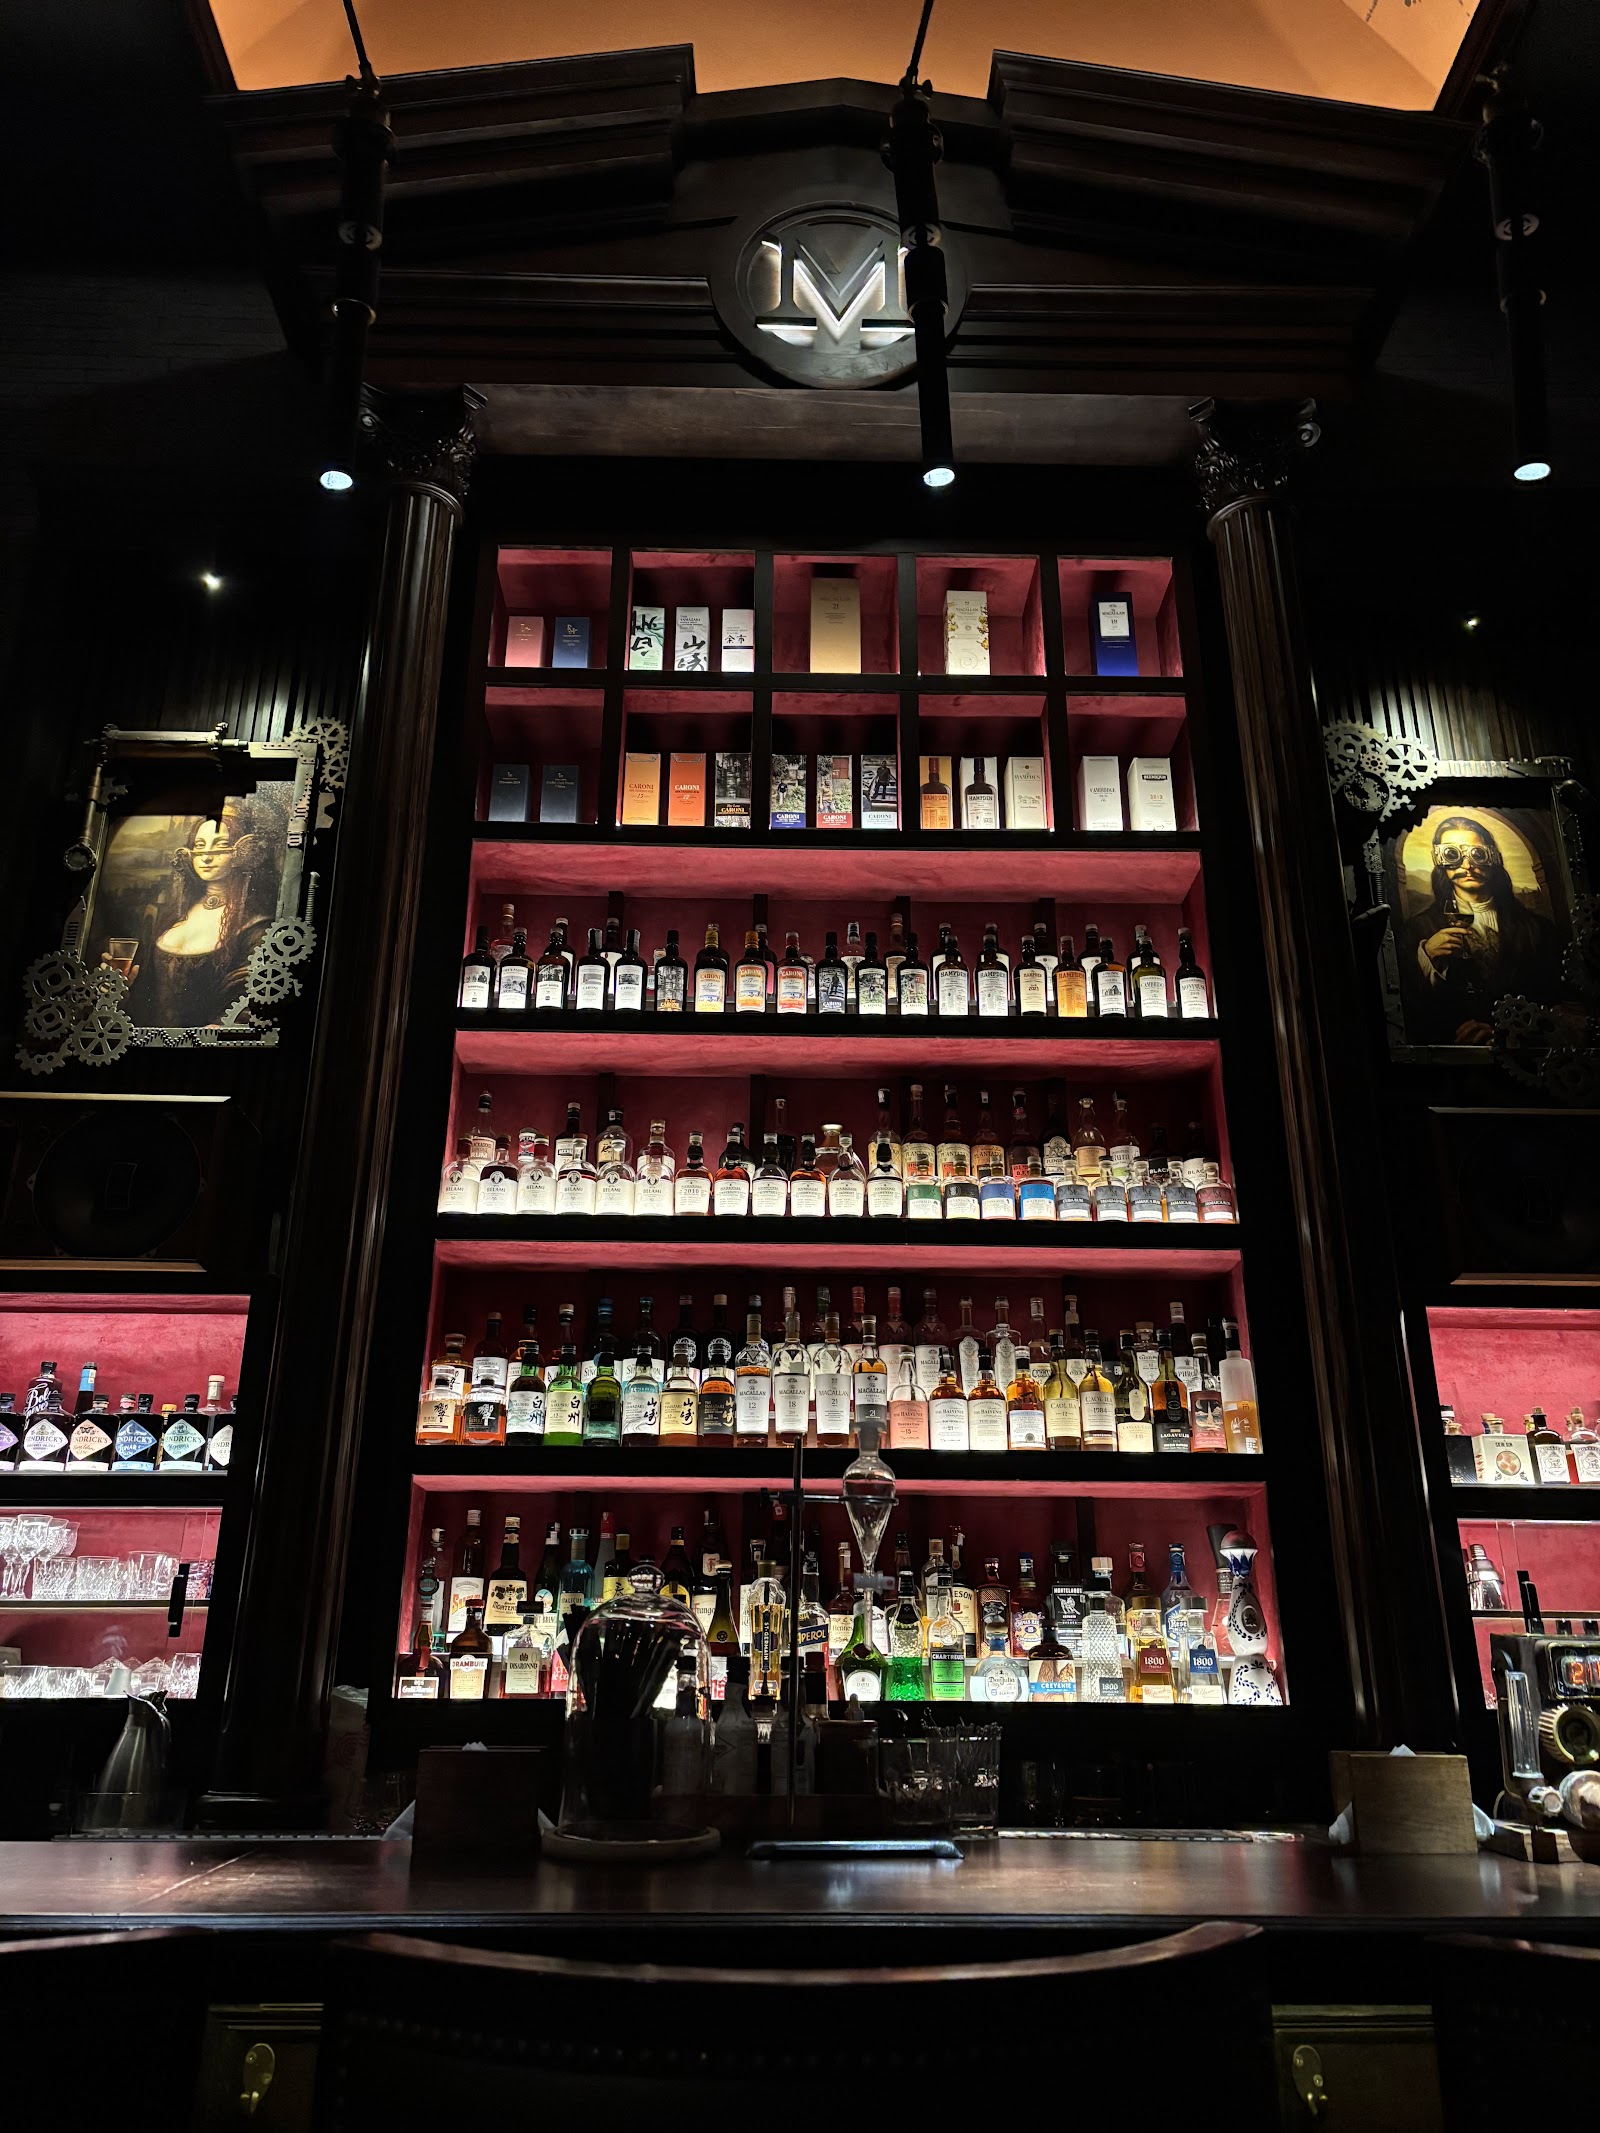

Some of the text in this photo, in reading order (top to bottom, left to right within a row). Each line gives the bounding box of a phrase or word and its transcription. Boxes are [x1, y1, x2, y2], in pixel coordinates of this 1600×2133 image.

[724, 634, 747, 644] 余市
[1059, 971, 1085, 979] HAMPDEN
[530, 1395, 545, 1427] 白州
[567, 1395, 581, 1427] 白州
[643, 1397, 658, 1426] 山崎
[680, 1397, 695, 1426] 山崎
[722, 1396, 734, 1427] 山崎
[73, 1435, 108, 1444] NDRICK'S
[117, 1435, 152, 1443] ENDRICK'S
[165, 1435, 202, 1443] ENDRICK'S
[954, 1591, 973, 1601] ESON
[797, 1629, 827, 1643] APEROL
[932, 1652, 965, 1660] CHARTREUSE
[1144, 1656, 1165, 1666] 1800
[1193, 1657, 1214, 1666] 1800
